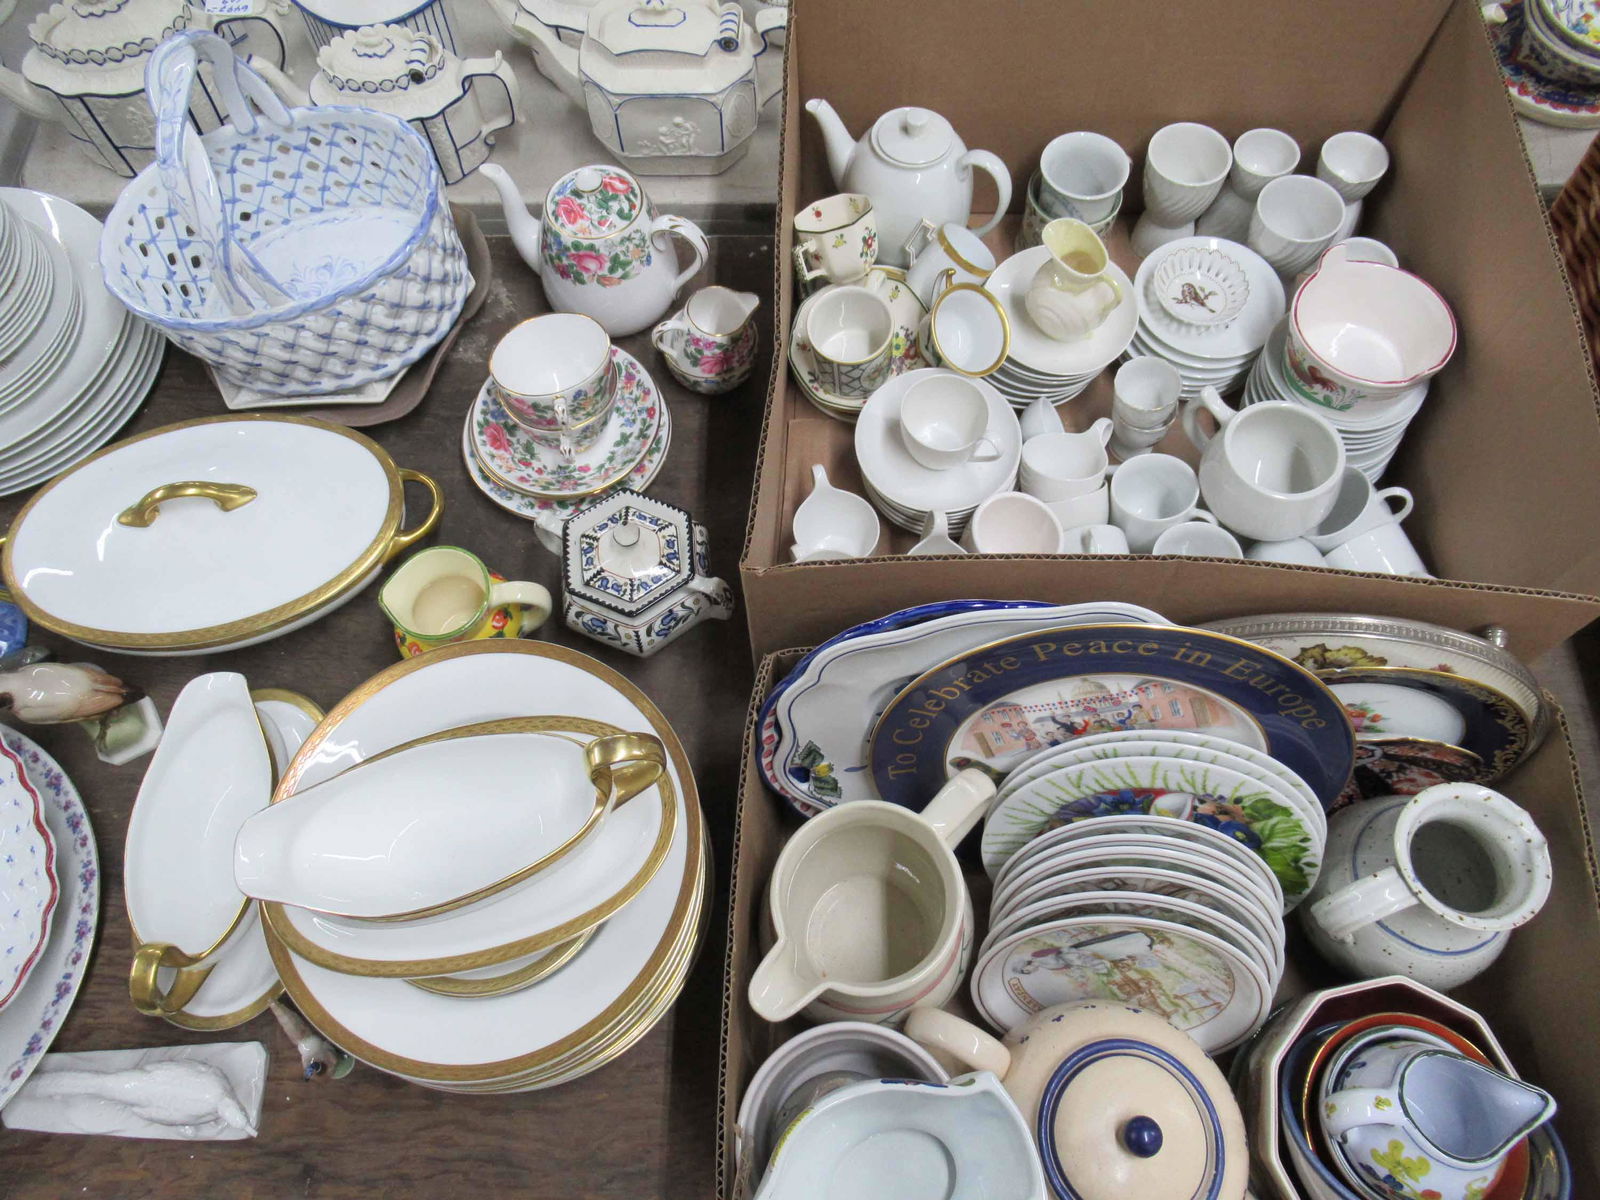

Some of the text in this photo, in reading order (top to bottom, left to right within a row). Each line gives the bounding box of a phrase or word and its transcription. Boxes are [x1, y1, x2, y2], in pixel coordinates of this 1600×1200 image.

[887, 639, 1327, 781] To Celebrate Peace in Europe
